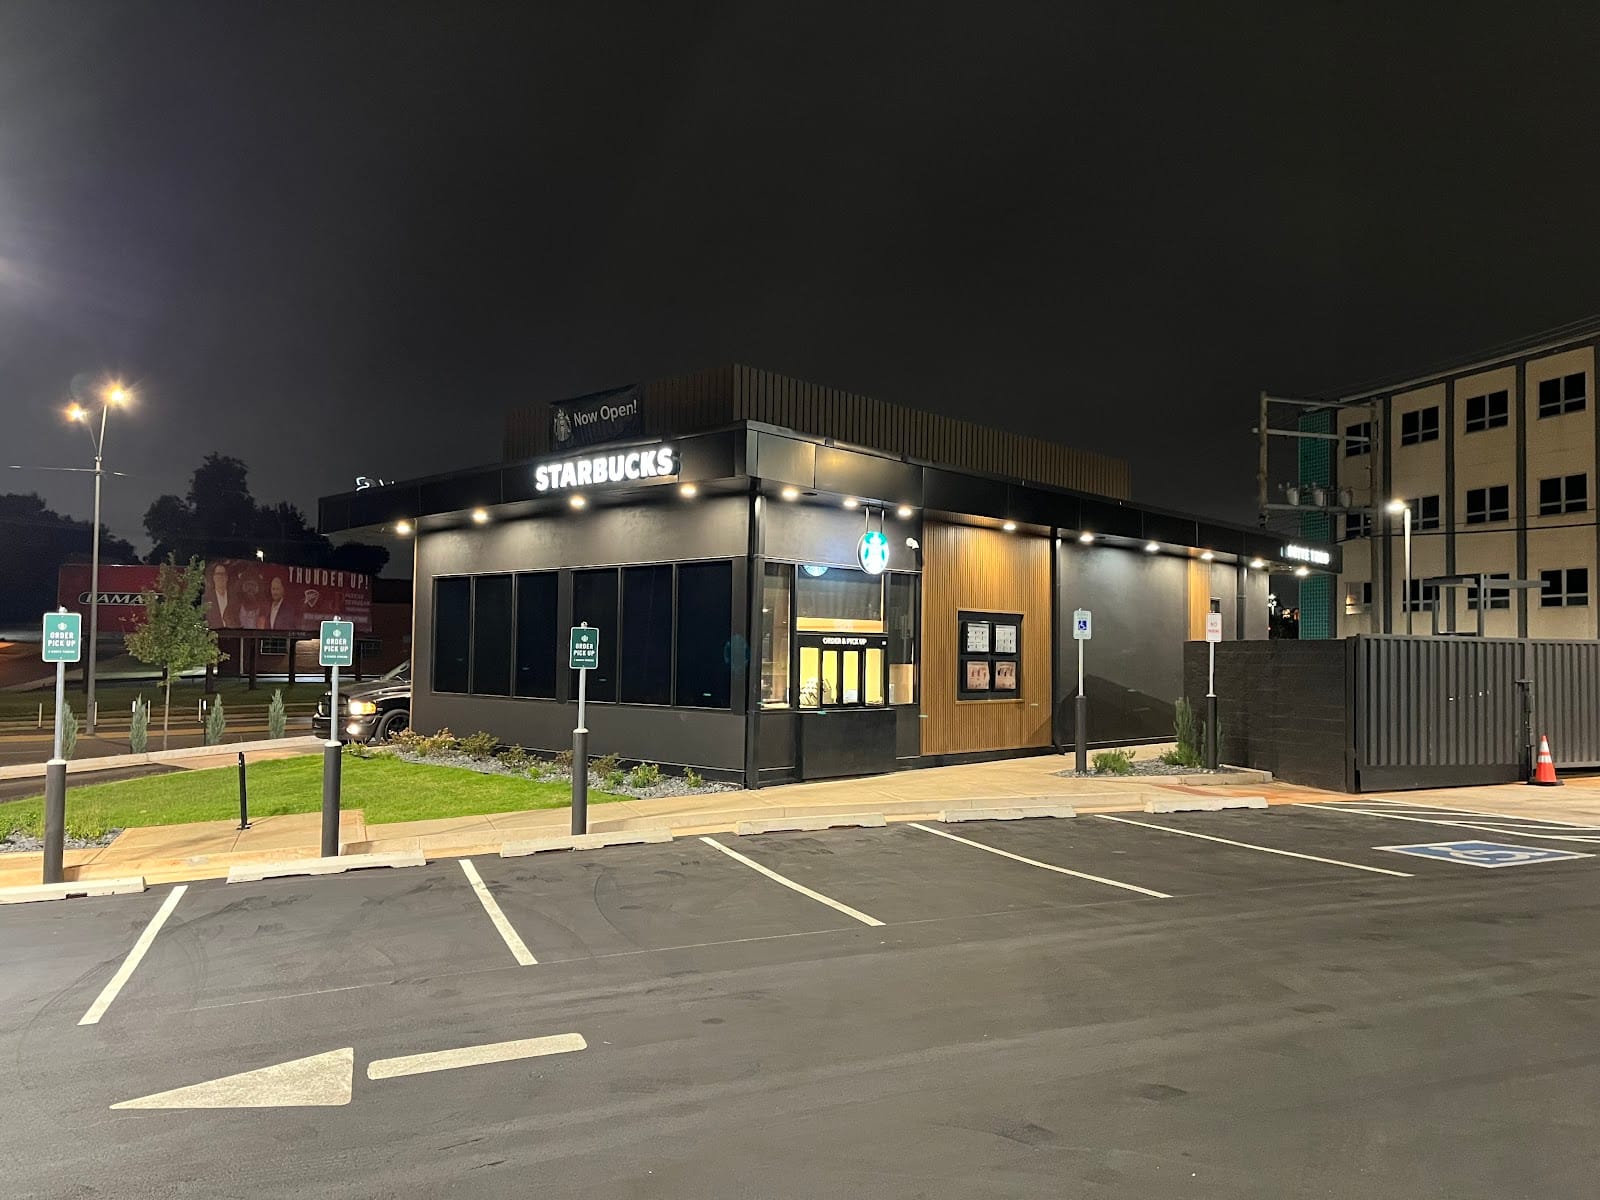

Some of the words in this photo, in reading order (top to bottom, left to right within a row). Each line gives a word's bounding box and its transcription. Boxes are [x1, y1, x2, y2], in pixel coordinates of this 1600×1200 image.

[573, 411, 598, 427] Now
[600, 399, 637, 422] Open!
[535, 448, 674, 491] STARBUCKS
[288, 566, 343, 587] THUNDER
[350, 573, 368, 589] UP!
[49, 631, 74, 639] ORDER
[47, 639, 65, 647] PICK
[66, 639, 76, 647] UP
[326, 638, 347, 646] ORDER
[573, 649, 587, 657] PICK
[587, 649, 596, 657] UP
